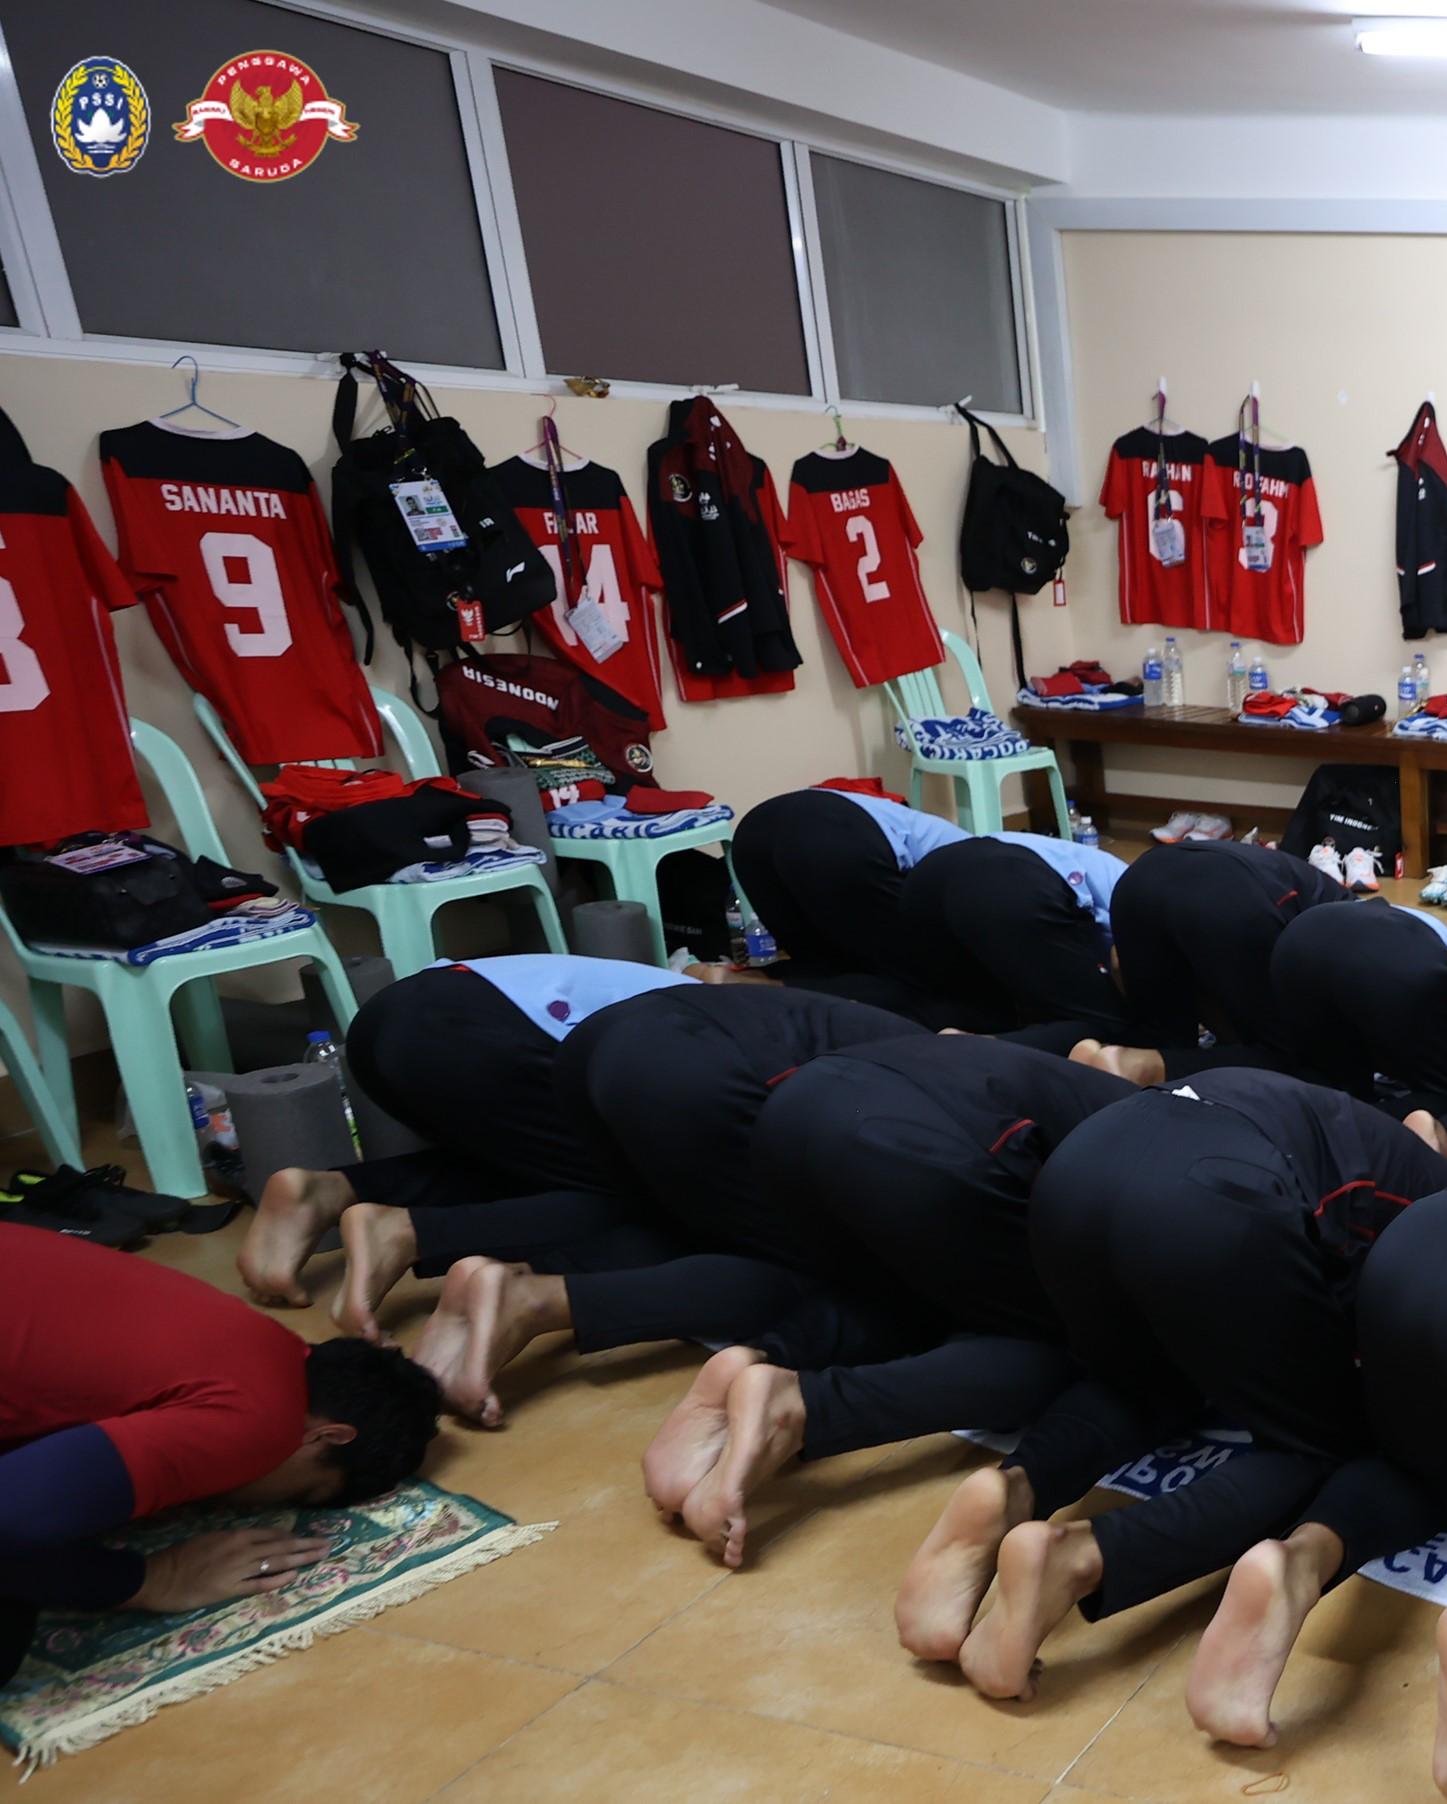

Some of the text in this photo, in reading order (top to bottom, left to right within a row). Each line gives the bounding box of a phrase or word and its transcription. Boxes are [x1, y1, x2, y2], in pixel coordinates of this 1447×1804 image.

[1142, 460, 1192, 482] RAHAN
[161, 484, 287, 519] SANANTA
[543, 512, 599, 534] FAR
[830, 488, 870, 512] BAGAS
[1147, 489, 1185, 561] 6
[845, 515, 891, 603] 2
[200, 532, 293, 657] 9
[538, 544, 631, 646] 14
[462, 665, 559, 711] NDONESIA
